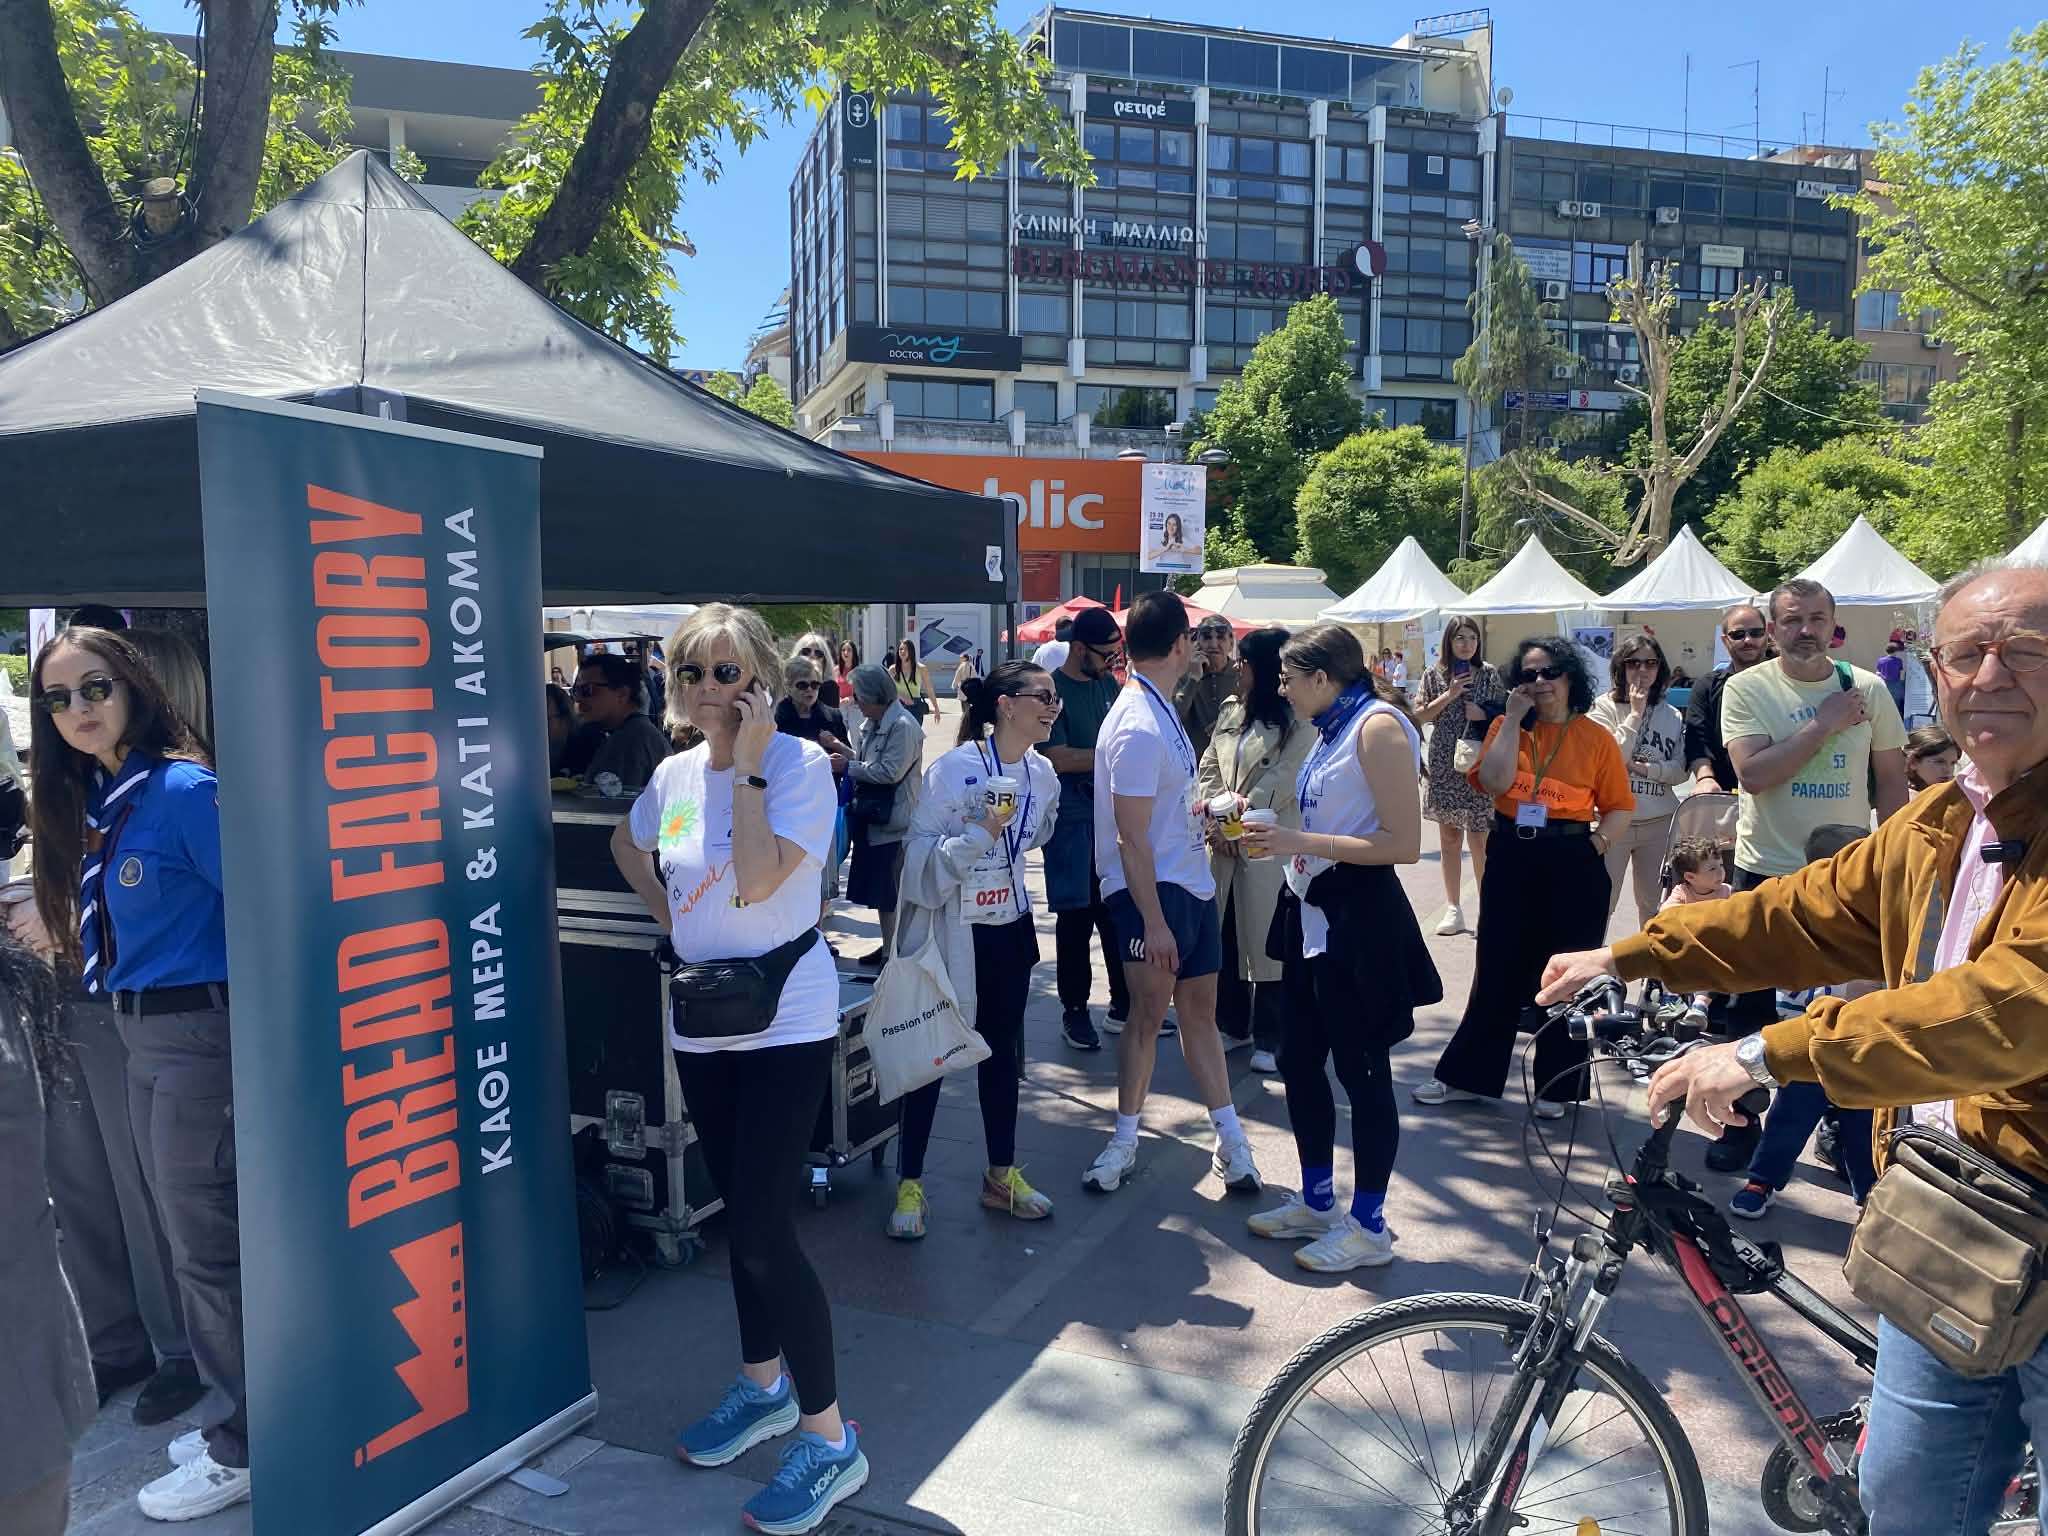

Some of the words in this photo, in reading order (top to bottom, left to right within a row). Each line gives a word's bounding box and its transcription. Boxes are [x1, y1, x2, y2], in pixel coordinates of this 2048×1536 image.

[1012, 213, 1096, 235] ΚΛΙΝΙΚΗ
[889, 350, 924, 360] DOCTOR
[444, 507, 487, 696] ΑΚΟΜΑ
[307, 483, 445, 902] FACTORY
[457, 717, 495, 830] ΚΑΤΙ
[1833, 754, 1846, 769] 53
[1791, 782, 1851, 799] PARADISE
[465, 846, 498, 881] &
[976, 888, 1010, 907] 0217
[469, 901, 506, 1021] ΜΕΡΑ
[881, 1016, 921, 1038] Passion
[922, 1008, 936, 1021] for
[936, 1000, 951, 1012] life
[337, 918, 461, 1229] BREAD
[476, 1041, 513, 1175] ΚΑΘΕ
[1706, 1297, 1826, 1462] ORIENT
[810, 1464, 840, 1501] HOKA
